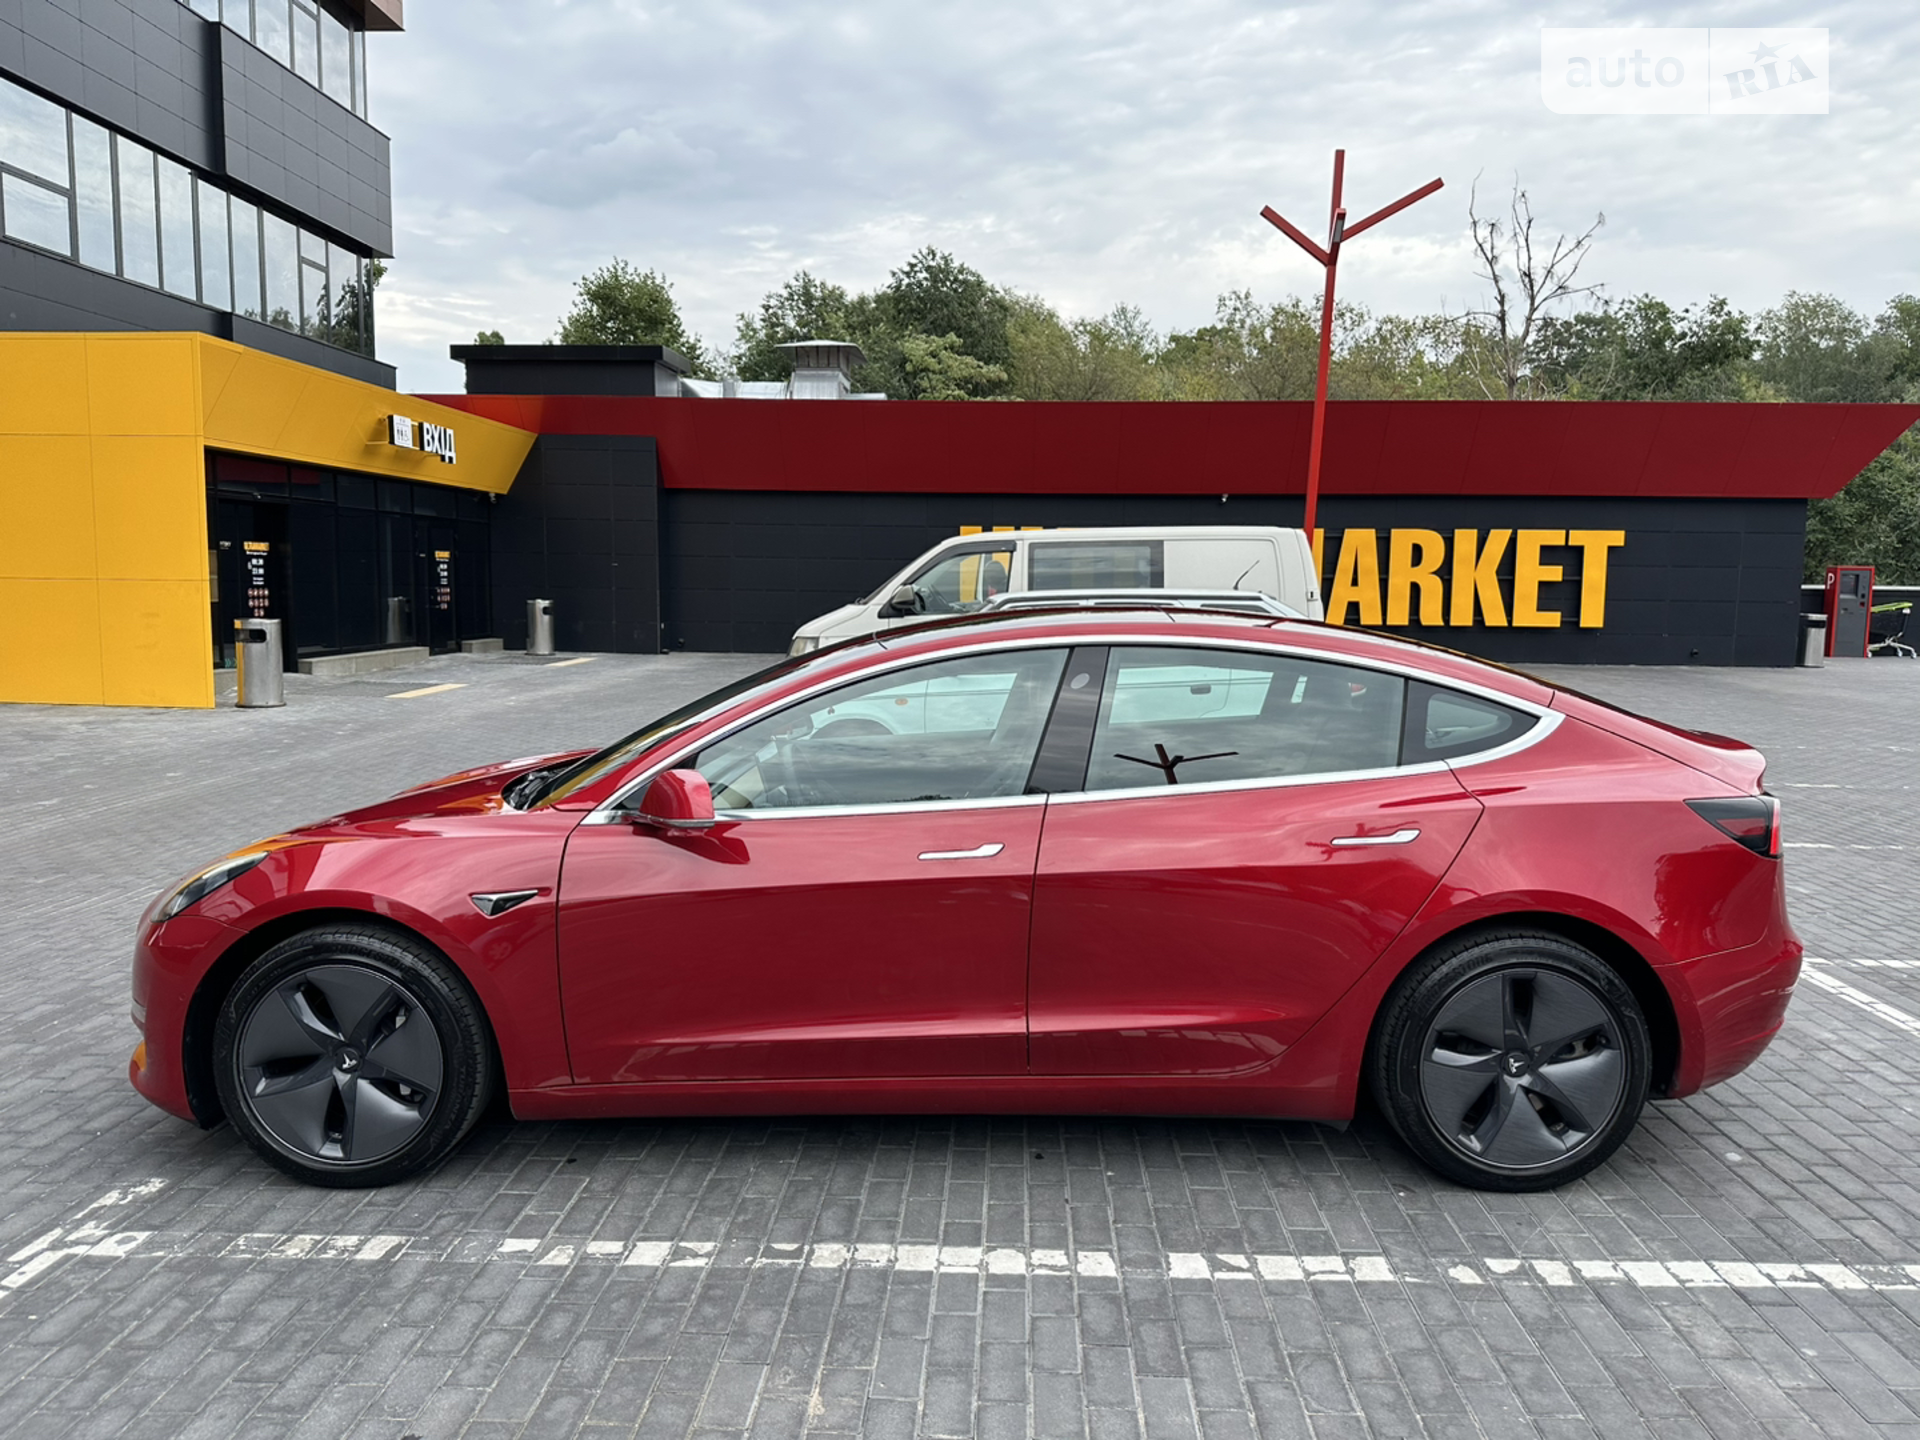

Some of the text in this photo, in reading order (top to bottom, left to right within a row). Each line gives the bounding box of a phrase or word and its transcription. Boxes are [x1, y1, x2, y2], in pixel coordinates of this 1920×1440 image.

[423, 421, 457, 464] ВХІД
[1313, 527, 1626, 628] ARKET
[1827, 573, 1836, 589] P
